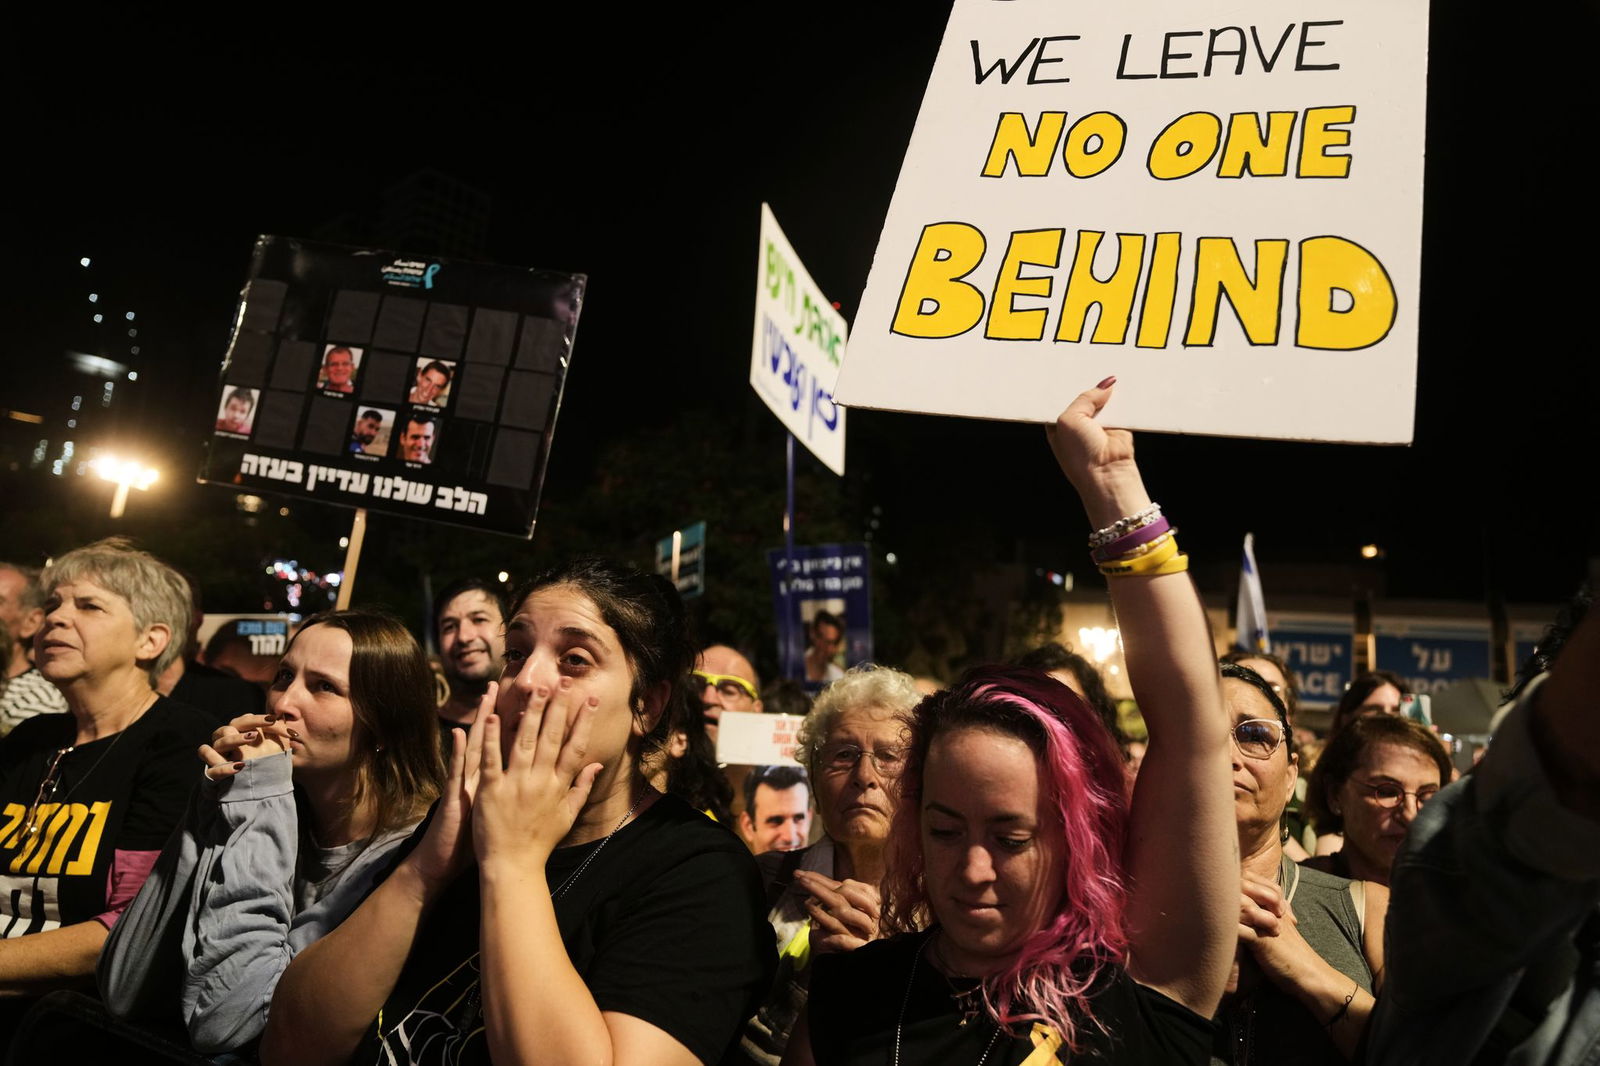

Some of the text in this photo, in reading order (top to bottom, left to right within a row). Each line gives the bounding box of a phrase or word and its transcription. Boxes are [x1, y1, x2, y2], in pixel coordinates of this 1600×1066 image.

[970, 20, 1343, 85] WE LEAVE
[980, 105, 1356, 180] NO ONE
[889, 222, 1398, 351] BEHIND
[240, 453, 488, 515] הלב שלנו עדיין בעזה
[1274, 641, 1343, 666] ישרא
[1411, 643, 1452, 672] על
